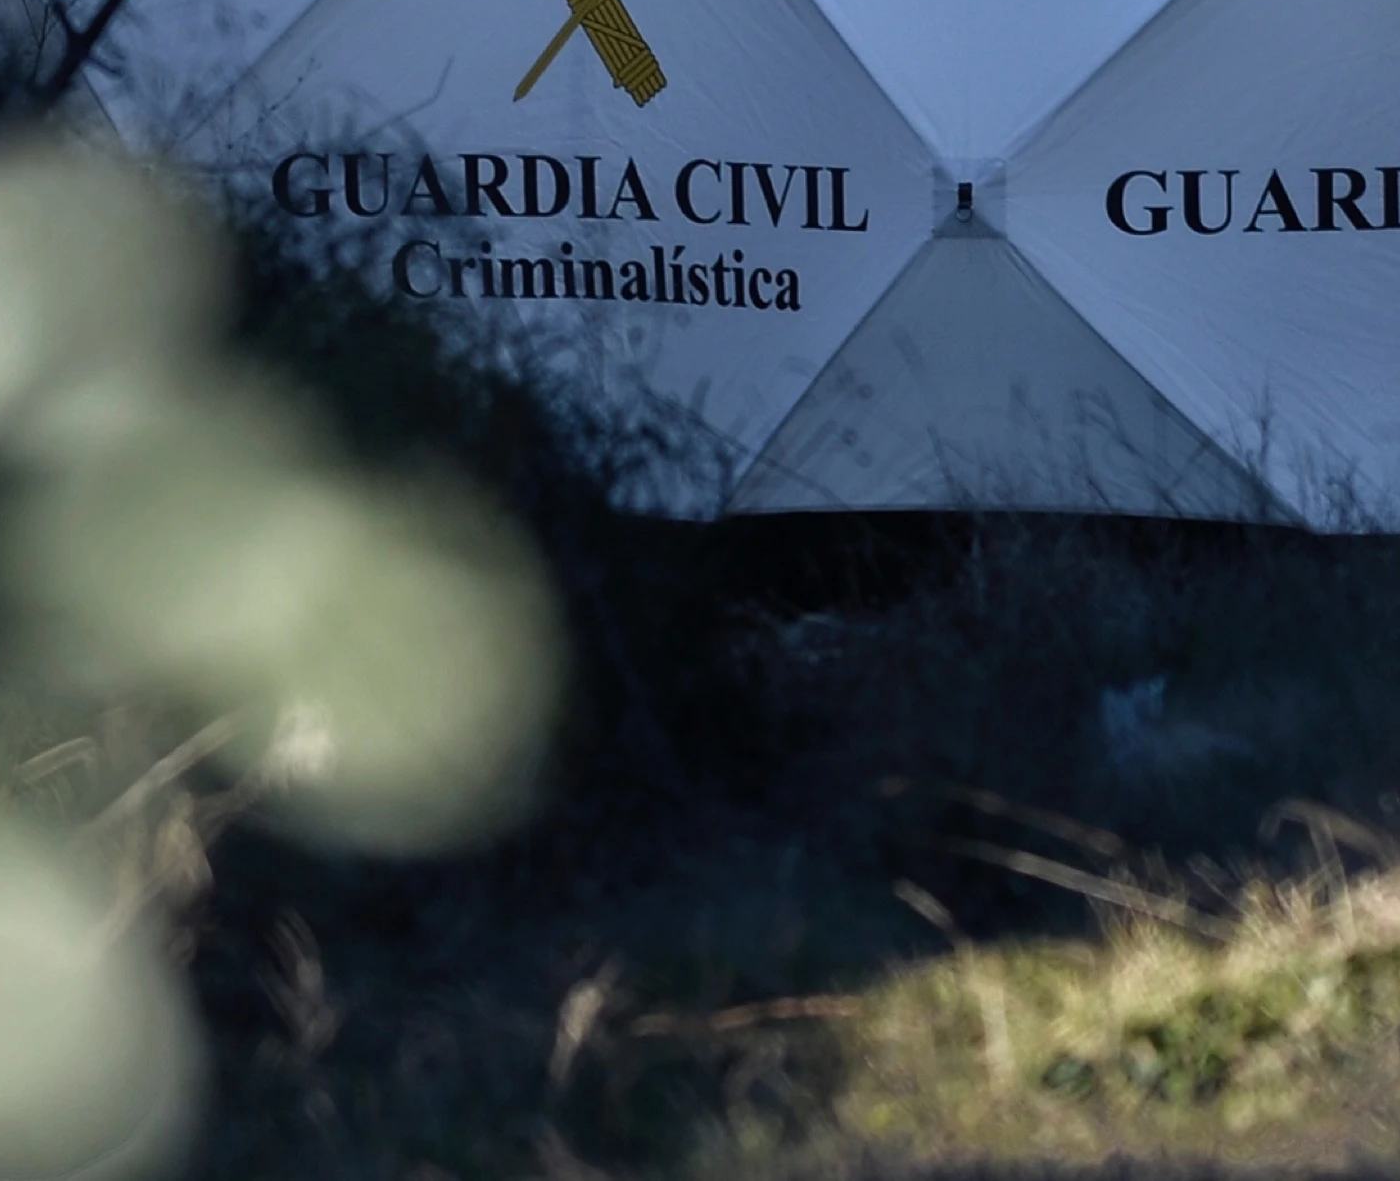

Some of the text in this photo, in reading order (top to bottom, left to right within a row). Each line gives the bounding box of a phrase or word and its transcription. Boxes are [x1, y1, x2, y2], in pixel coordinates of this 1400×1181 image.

[271, 153, 870, 232] GUARDIA CIVIL
[393, 240, 801, 312] Criminalística
